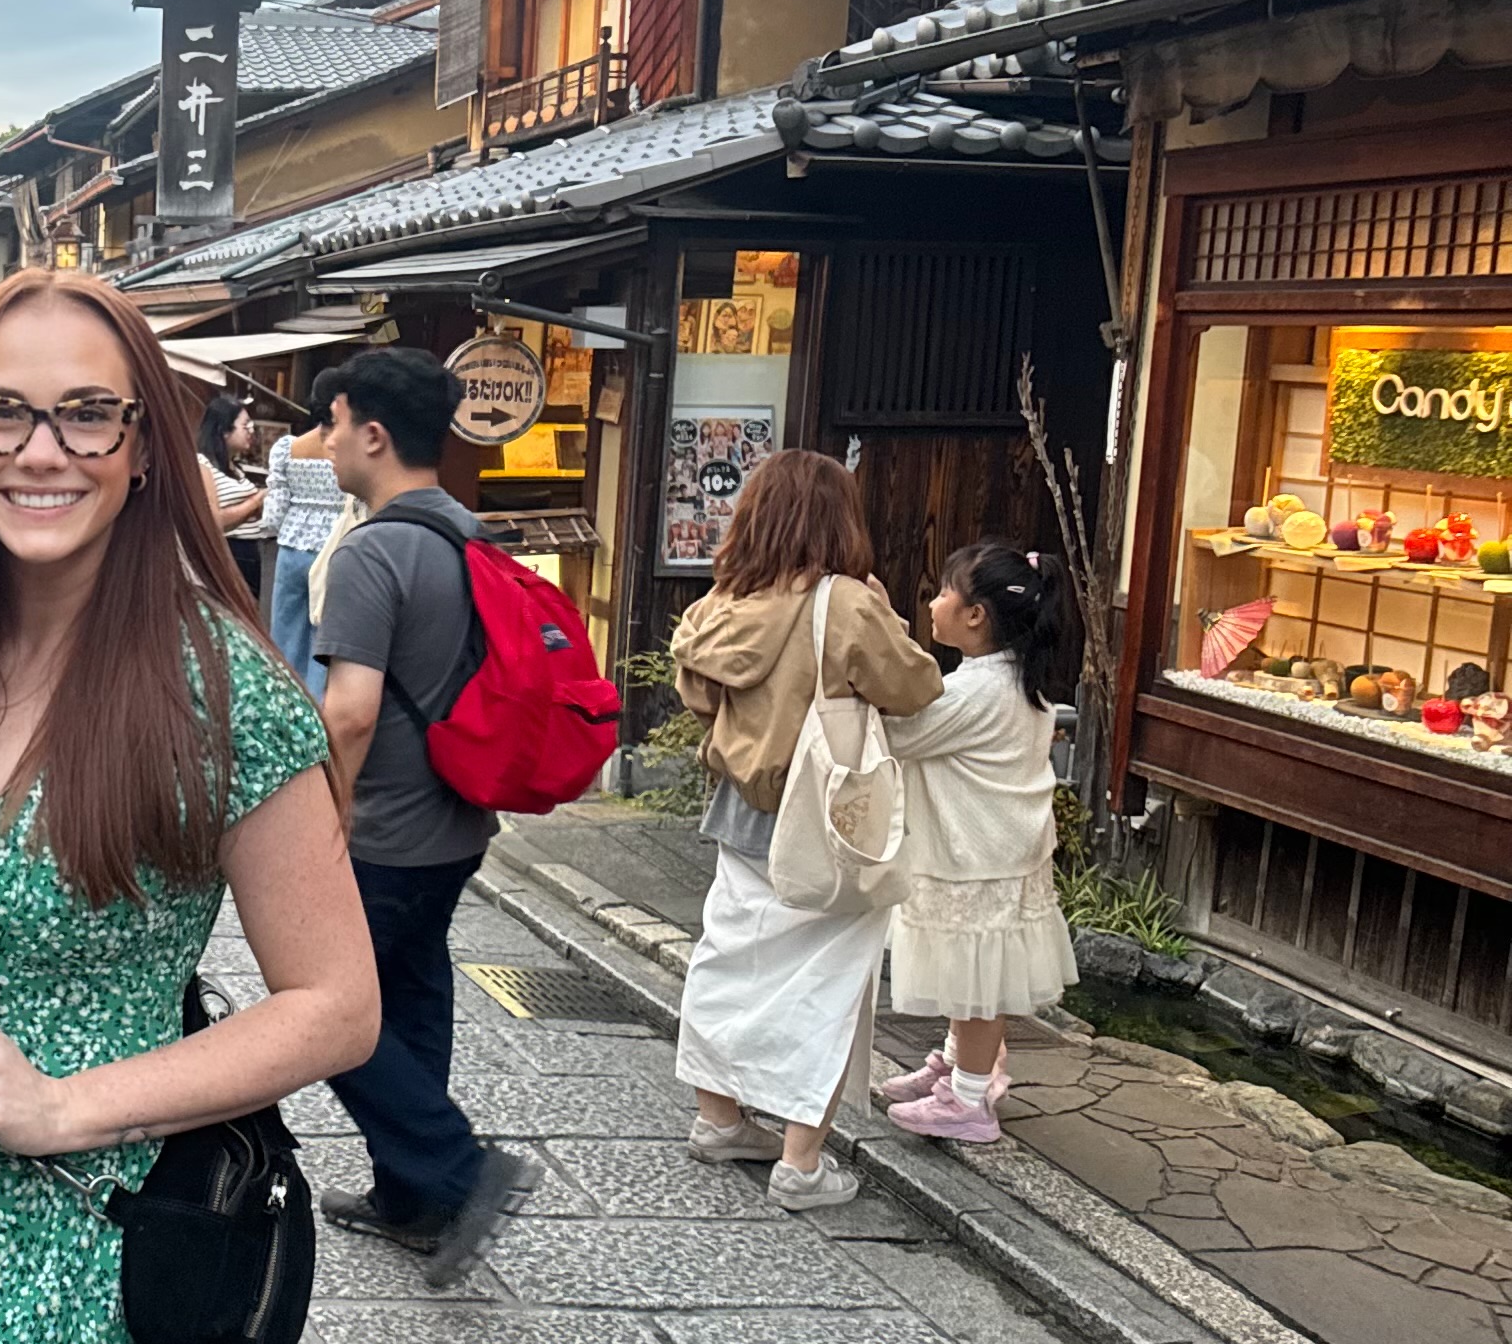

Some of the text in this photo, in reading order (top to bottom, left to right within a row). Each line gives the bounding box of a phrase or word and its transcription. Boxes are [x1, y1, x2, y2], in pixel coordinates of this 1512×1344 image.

[178, 24, 228, 191] 二井三
[1372, 373, 1505, 433] Candy
